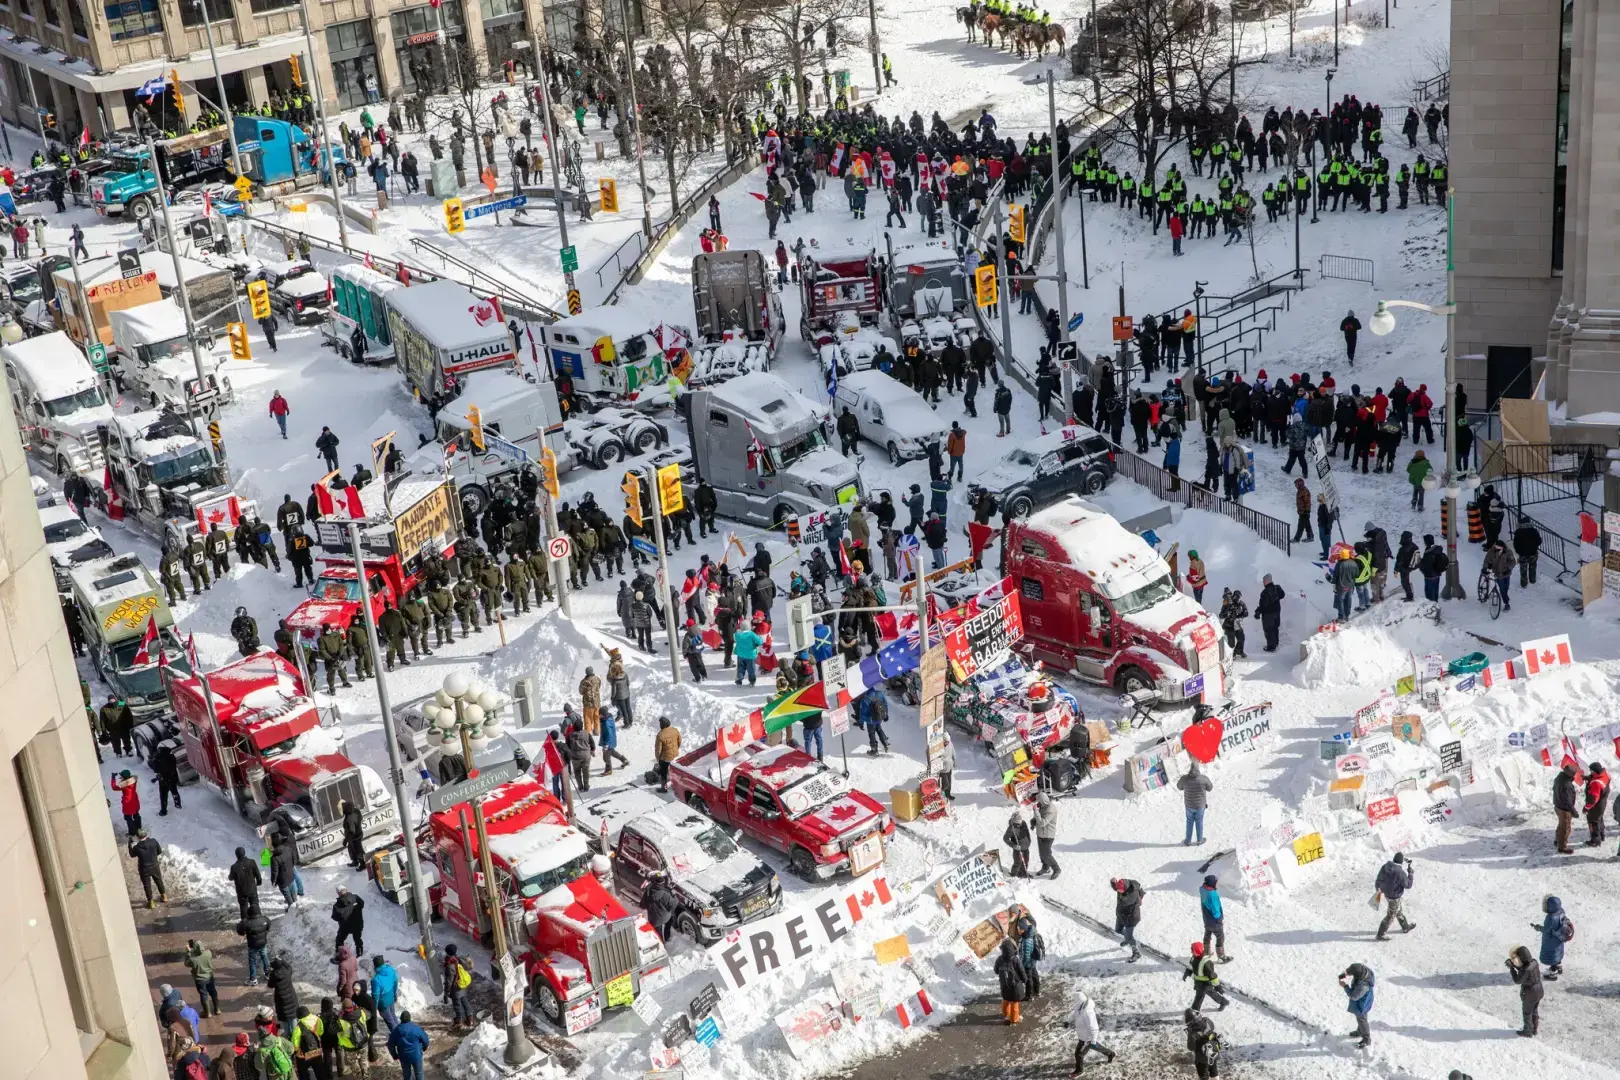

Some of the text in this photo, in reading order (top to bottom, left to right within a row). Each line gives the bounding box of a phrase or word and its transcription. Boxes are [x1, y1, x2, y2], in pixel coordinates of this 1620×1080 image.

[412, 34, 439, 44] CHIPOTL
[195, 238, 214, 247] GEORGE
[124, 270, 142, 278] SUSSEX
[450, 343, 510, 364] U-HAUL
[402, 491, 442, 534] MANDATE
[403, 508, 449, 551] FREEDOM
[125, 597, 160, 628] worship
[956, 597, 1011, 644] FREEDOM
[991, 611, 1018, 638] ENFANTS
[828, 657, 839, 666] STOP
[828, 670, 842, 679] LIGNE
[1222, 706, 1266, 731] ANDATE
[1221, 719, 1271, 752] FREEDOM
[361, 808, 395, 830] STAND
[298, 833, 335, 855] UNITED
[1297, 846, 1326, 866] POLICE
[955, 864, 992, 891] VACCINES
[956, 861, 971, 877] NOT
[975, 873, 997, 889] ABOUT
[721, 899, 848, 989] FREE
